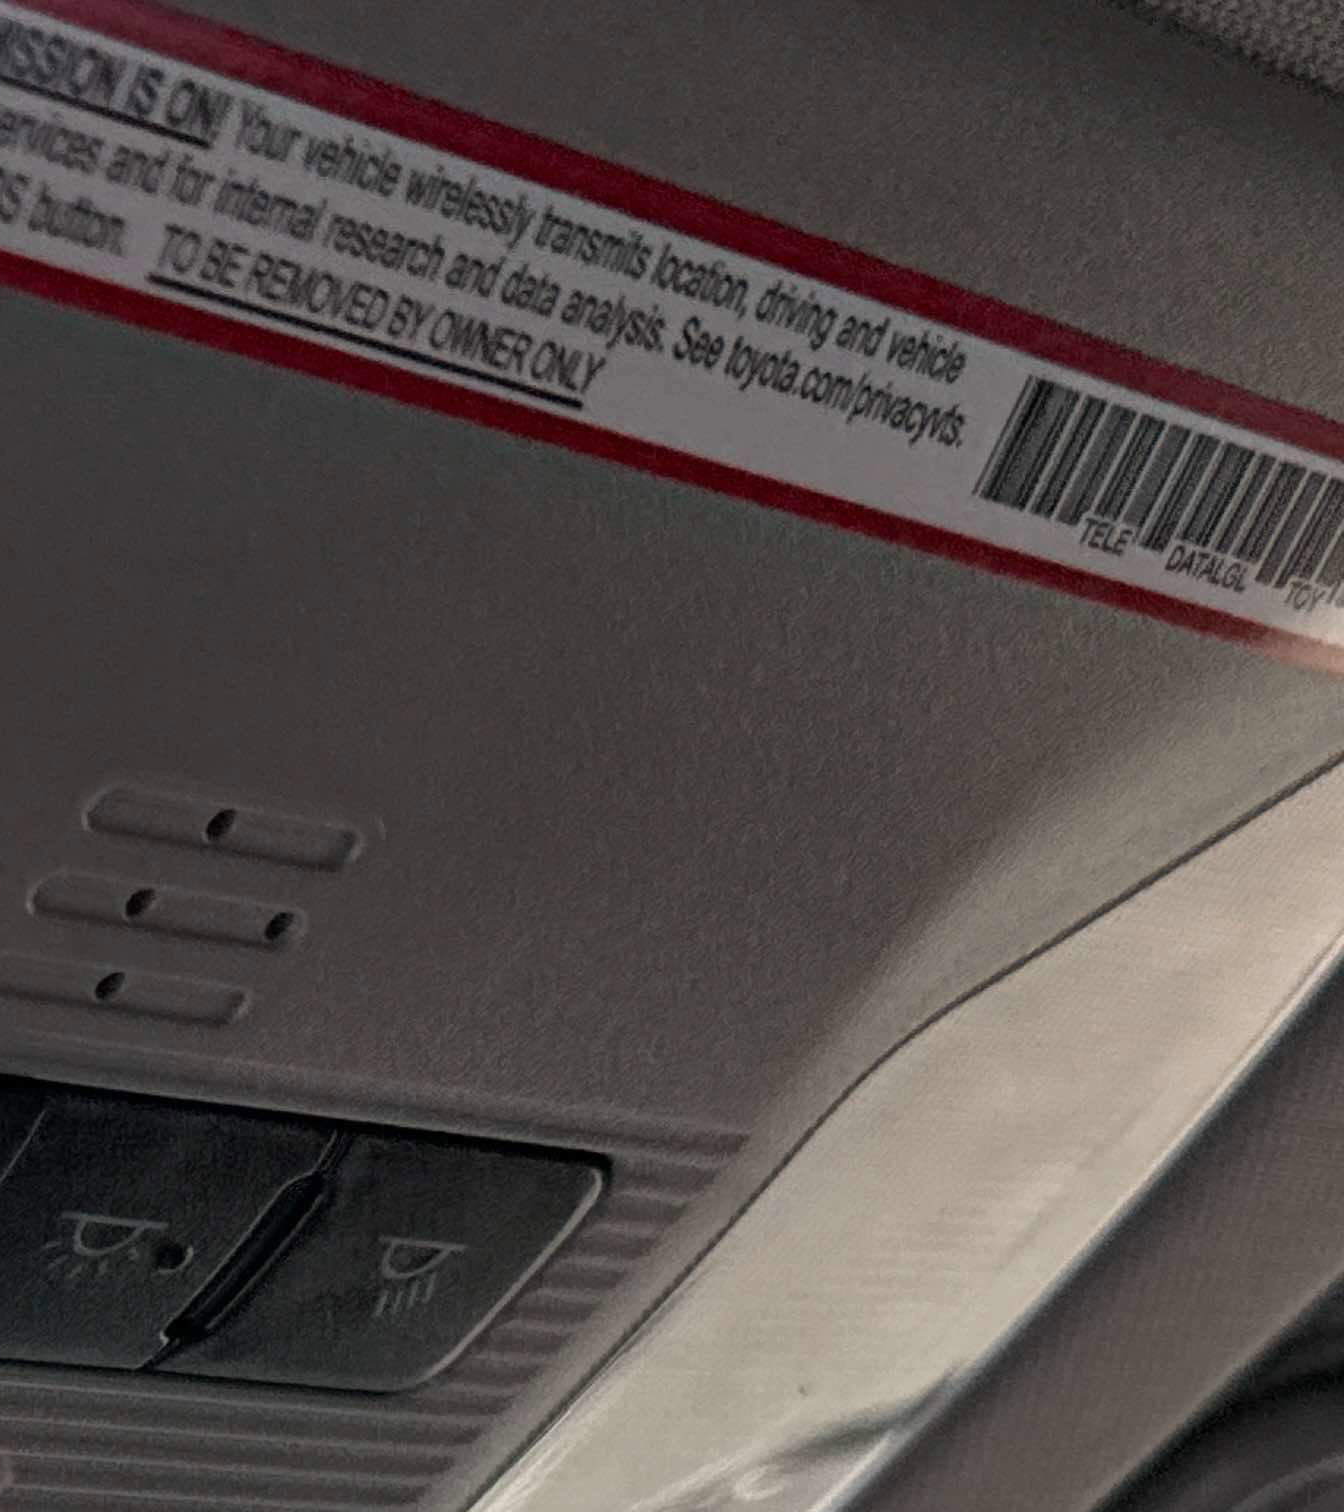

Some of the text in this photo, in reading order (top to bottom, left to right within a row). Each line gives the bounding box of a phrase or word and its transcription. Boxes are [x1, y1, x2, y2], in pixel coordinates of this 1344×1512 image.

[105, 142, 169, 194] and
[169, 152, 216, 205] for
[214, 167, 328, 241] internal
[324, 211, 445, 281] research
[445, 253, 507, 299] and
[501, 263, 561, 318] data
[560, 289, 667, 353] analysis.
[672, 315, 725, 371] See
[724, 335, 965, 449] toyota.com/privacyvts.
[126, 64, 165, 117] IS
[236, 103, 302, 161] Your
[303, 133, 403, 197] vehicle
[403, 165, 536, 249] wirelessly
[532, 203, 653, 279] transmits
[650, 242, 749, 319] location,
[755, 279, 839, 352] driving
[835, 316, 891, 357] and
[885, 331, 966, 384] vehicle
[158, 222, 201, 273] TO
[199, 237, 249, 288] BE
[251, 253, 390, 328] REMOVED
[387, 295, 434, 344] BY
[432, 309, 532, 375] OWNER
[529, 339, 606, 393] ONLY
[1080, 518, 1133, 557] TELE
